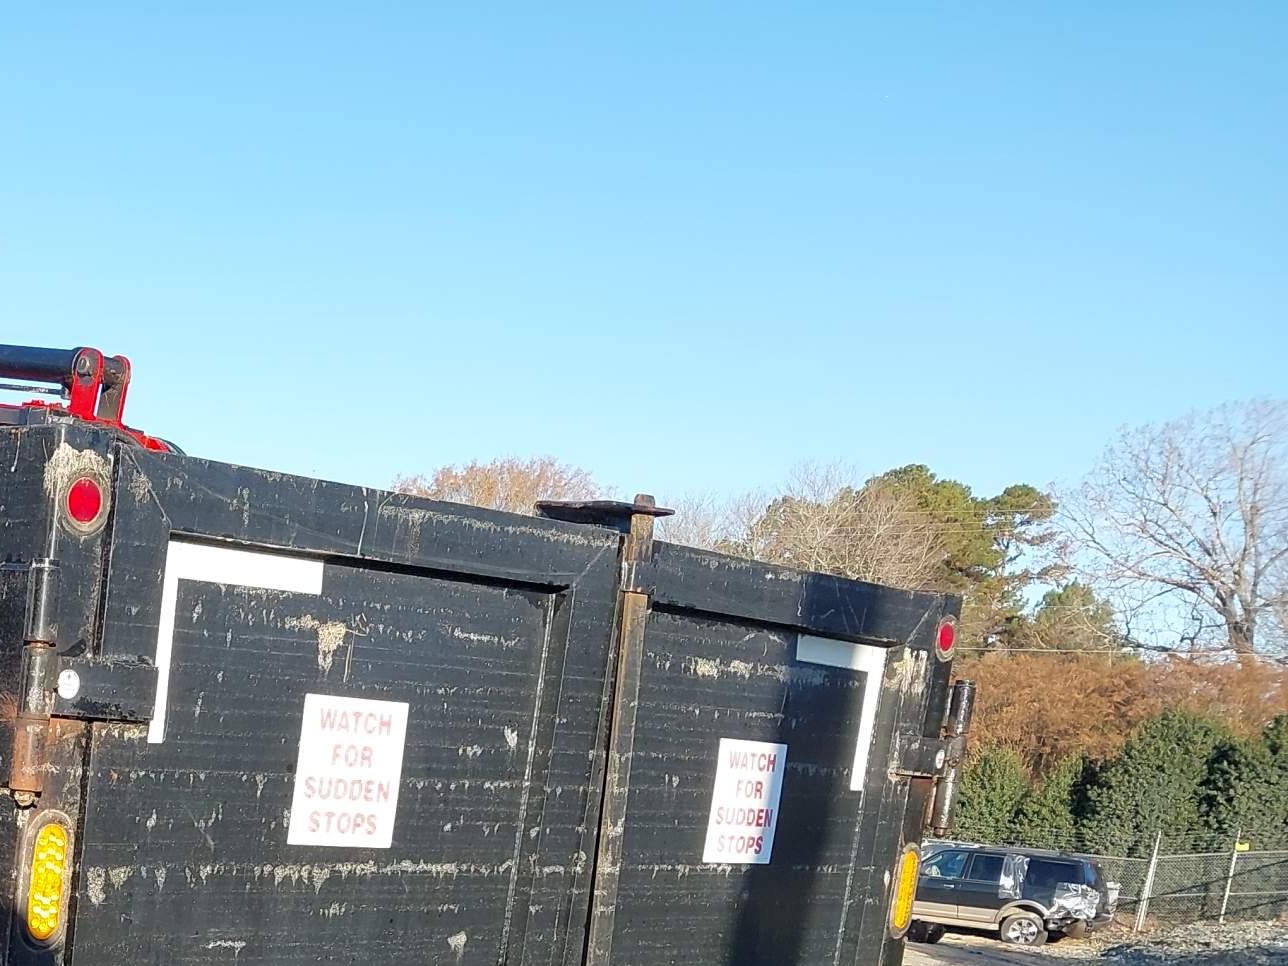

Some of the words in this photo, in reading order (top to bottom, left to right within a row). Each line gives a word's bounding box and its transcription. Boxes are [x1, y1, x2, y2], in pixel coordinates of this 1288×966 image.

[320, 708, 392, 736] WATCH
[331, 744, 374, 768] FOR
[729, 751, 777, 772] WATCH
[304, 776, 391, 802] SUDDEN
[736, 779, 763, 799] FOR
[308, 810, 377, 835] STOPS
[715, 806, 774, 828] SUDDEN
[717, 835, 764, 855] STOPS
